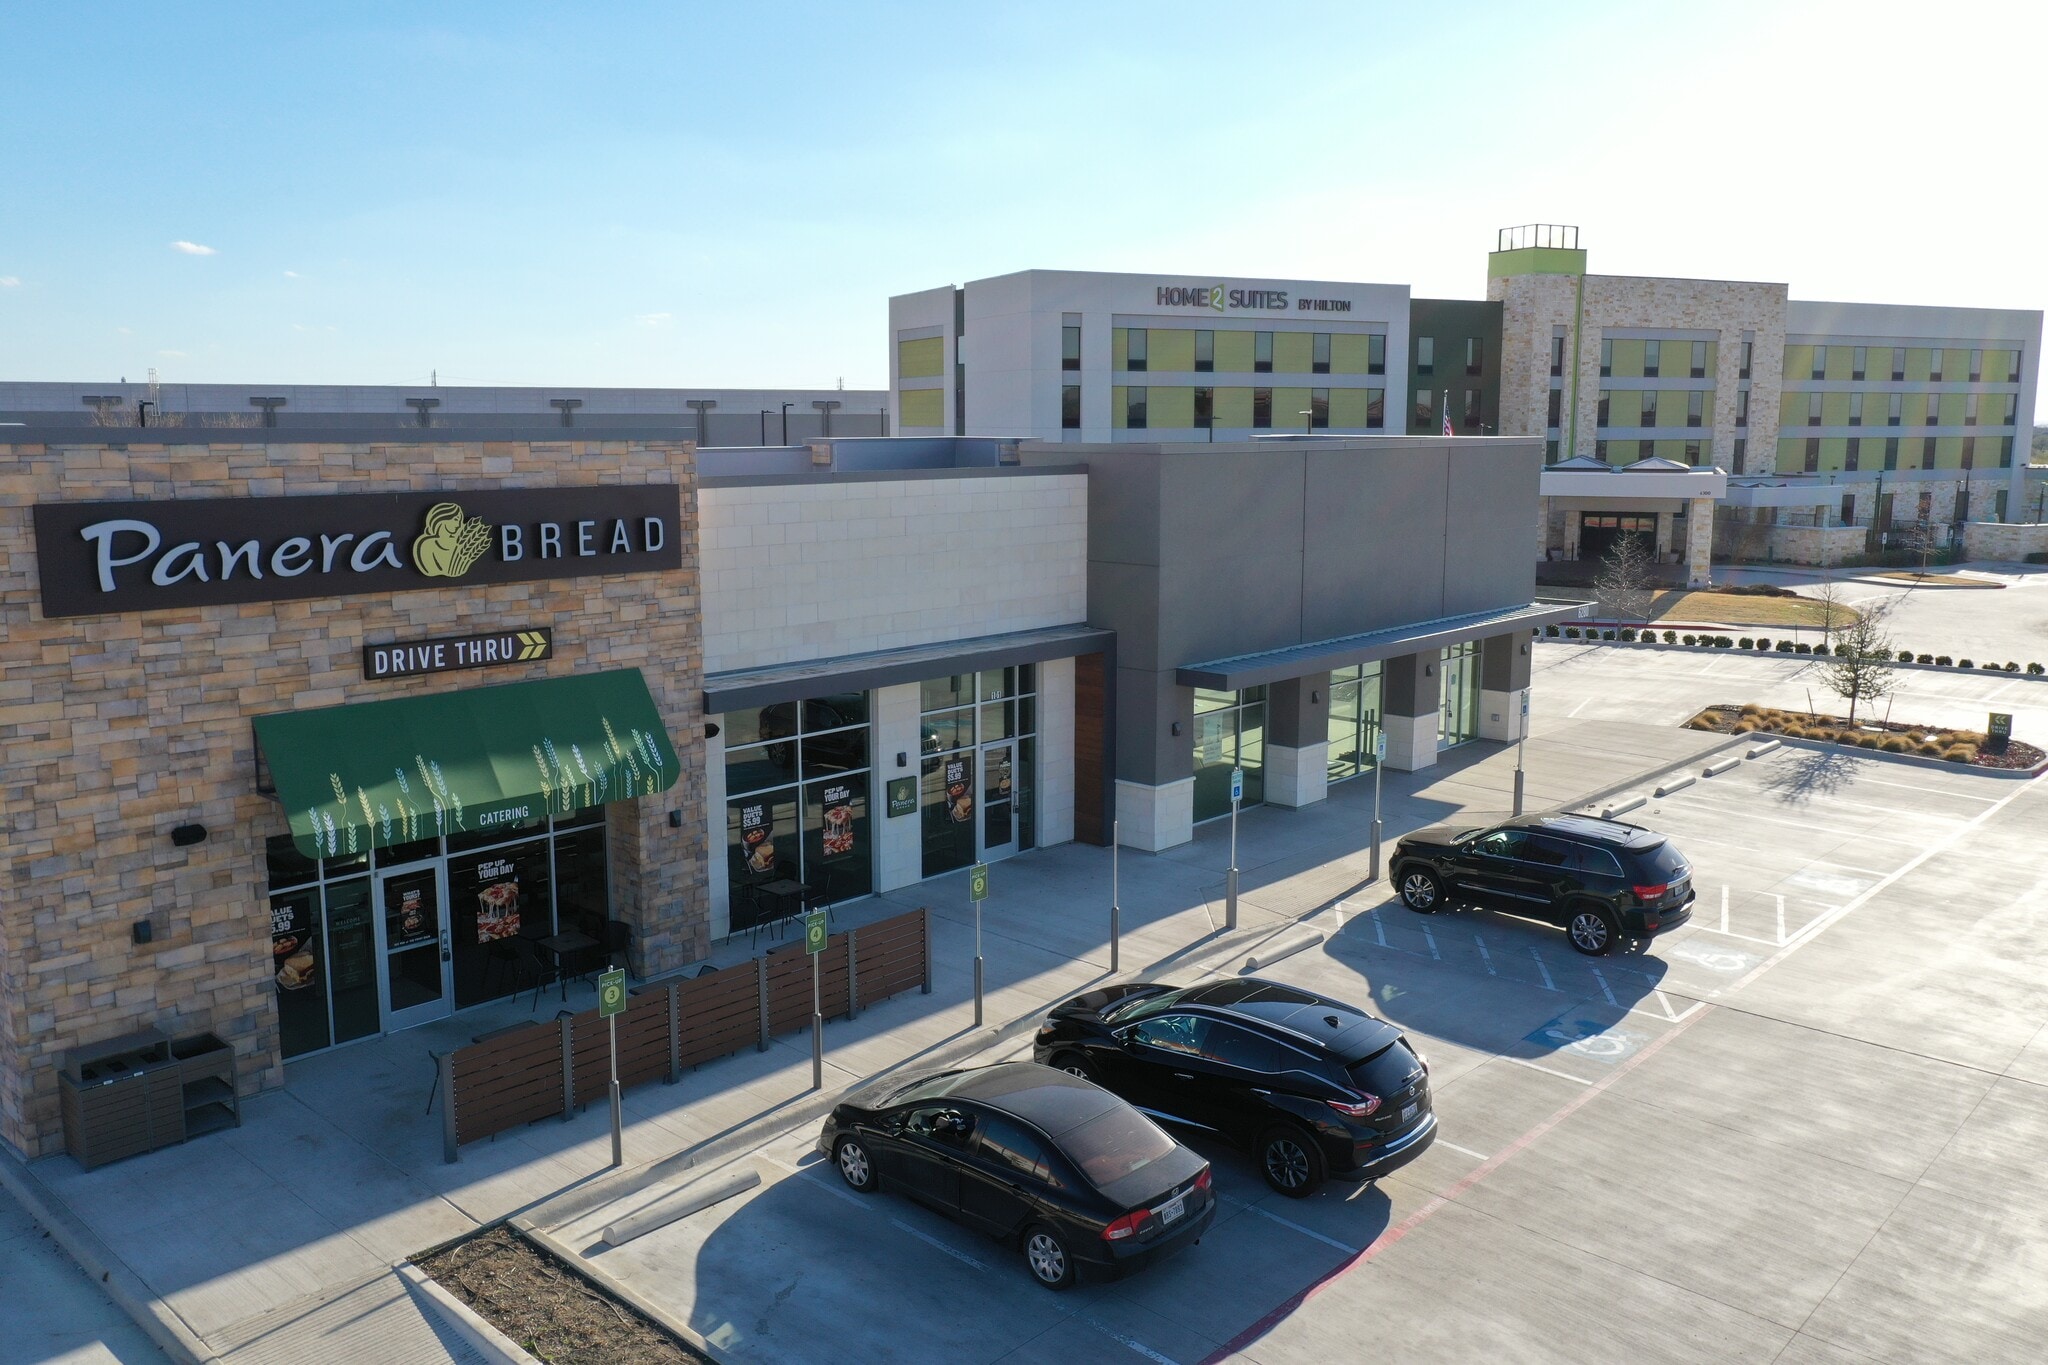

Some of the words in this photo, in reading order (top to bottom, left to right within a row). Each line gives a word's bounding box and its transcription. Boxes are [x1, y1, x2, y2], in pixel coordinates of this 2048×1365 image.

[1229, 290, 1288, 310] SUITES
[1298, 299, 1313, 310] BY
[1314, 300, 1351, 312] HILTON
[80, 519, 403, 593] Panera
[501, 517, 664, 562] BREAD
[375, 644, 446, 674] DRIVE
[454, 637, 513, 665] THRU
[947, 761, 963, 770] VALUE
[824, 787, 836, 795] PEP
[824, 791, 839, 802] YOUR
[840, 789, 850, 799] DAY
[743, 804, 763, 814] VALUE
[892, 798, 915, 809] Panera
[480, 805, 529, 826] CATERING
[743, 810, 763, 820] DUETS
[743, 816, 761, 828] $5.99
[478, 861, 494, 871] PEP
[494, 859, 506, 867] UP
[478, 867, 499, 880] YOUR
[499, 863, 514, 875] DAY
[270, 906, 293, 917] ALUE
[270, 912, 294, 924] UETS
[271, 920, 291, 934] 5.99
[601, 977, 623, 988] PICK-UP
[609, 989, 616, 1000] 3
